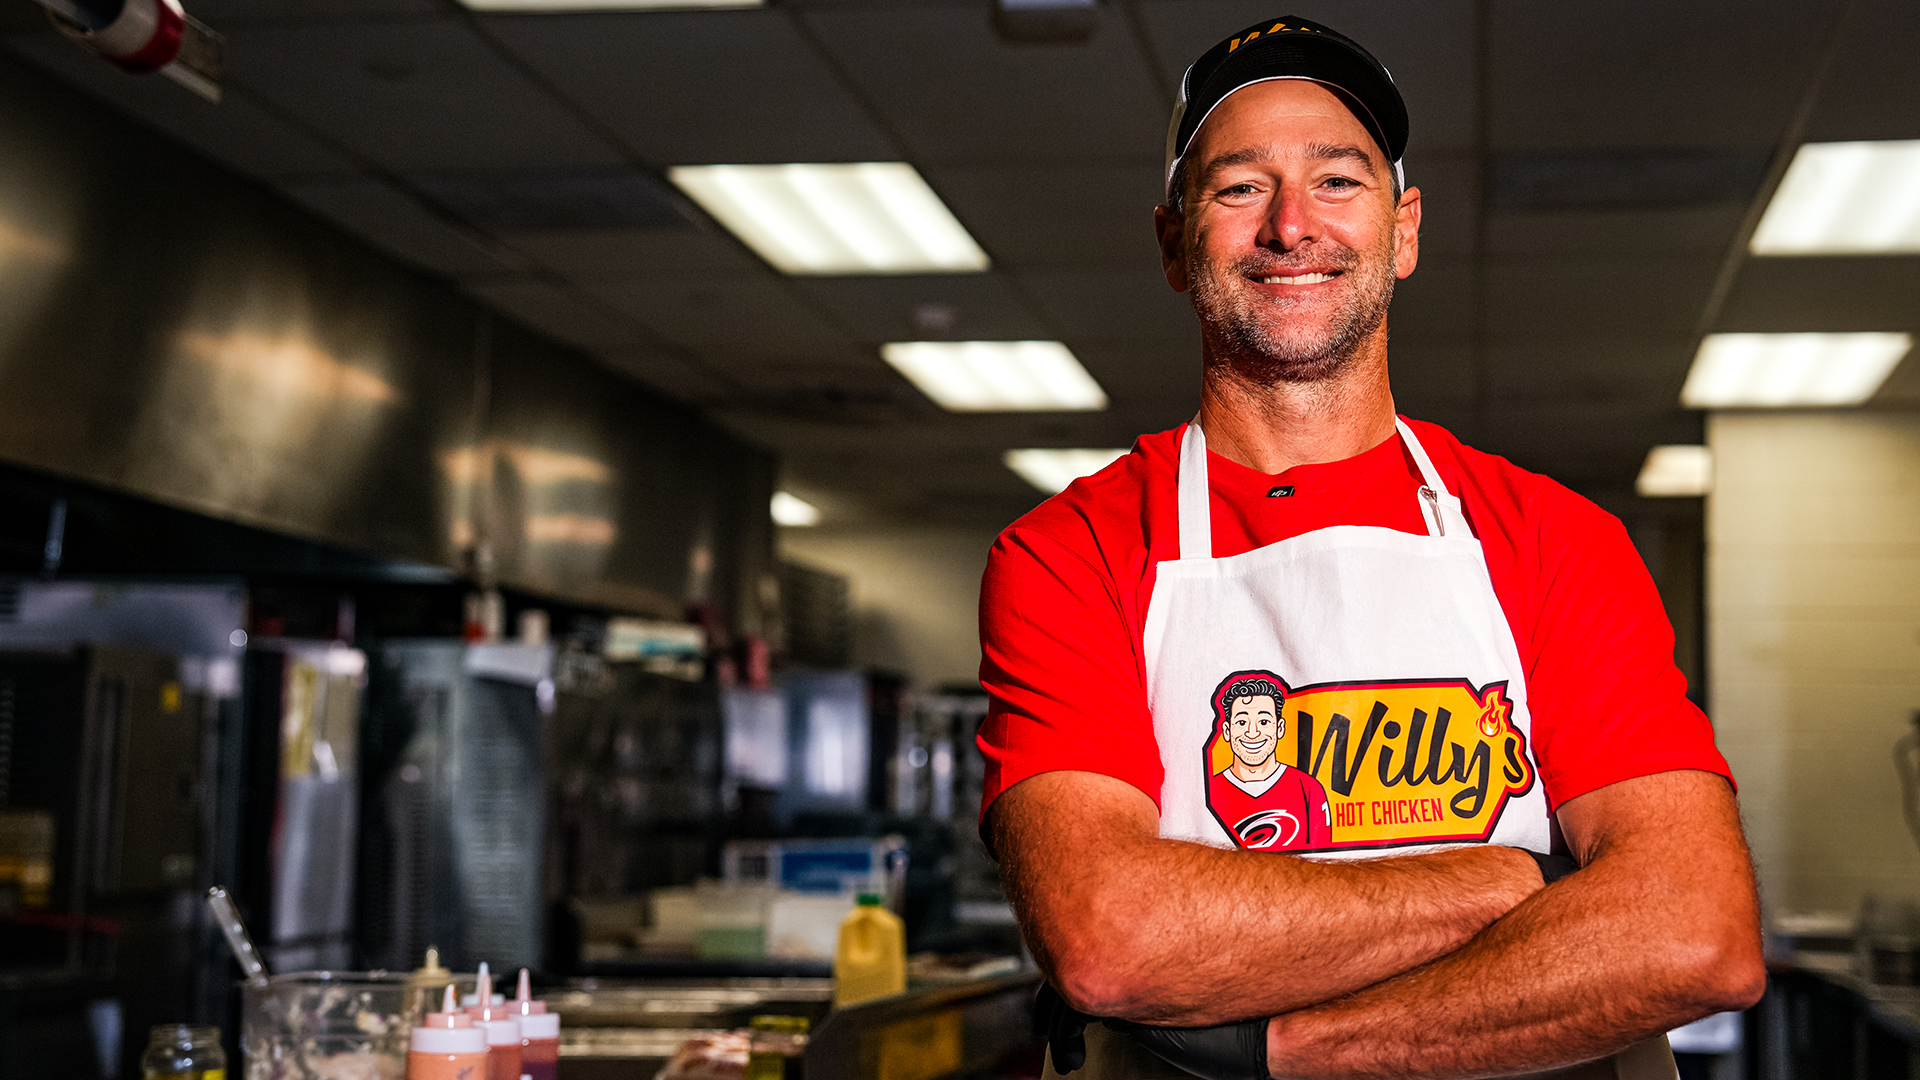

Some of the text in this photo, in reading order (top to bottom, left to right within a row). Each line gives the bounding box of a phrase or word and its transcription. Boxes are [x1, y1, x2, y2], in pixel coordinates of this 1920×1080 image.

[1297, 700, 1523, 819] Willy's
[1335, 798, 1444, 827] HOT CHICKEN
